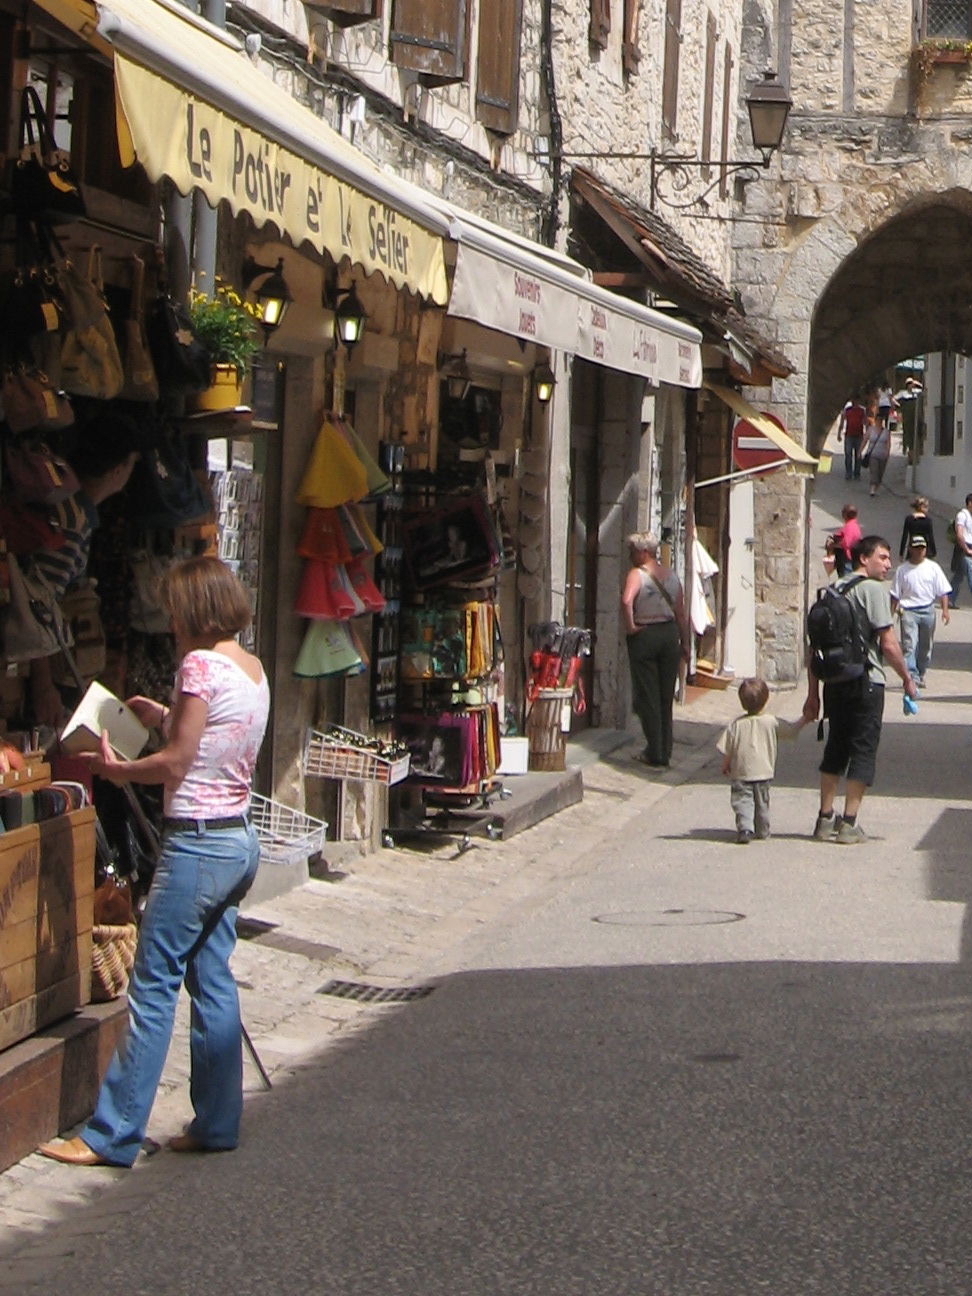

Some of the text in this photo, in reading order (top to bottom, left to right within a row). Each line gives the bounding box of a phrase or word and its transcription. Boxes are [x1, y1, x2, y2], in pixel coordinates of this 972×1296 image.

[187, 103, 212, 183] Le
[232, 128, 291, 218] Potier
[367, 204, 409, 276] Sellier
[514, 270, 541, 304] Souvenirs
[518, 307, 537, 336] Jouets
